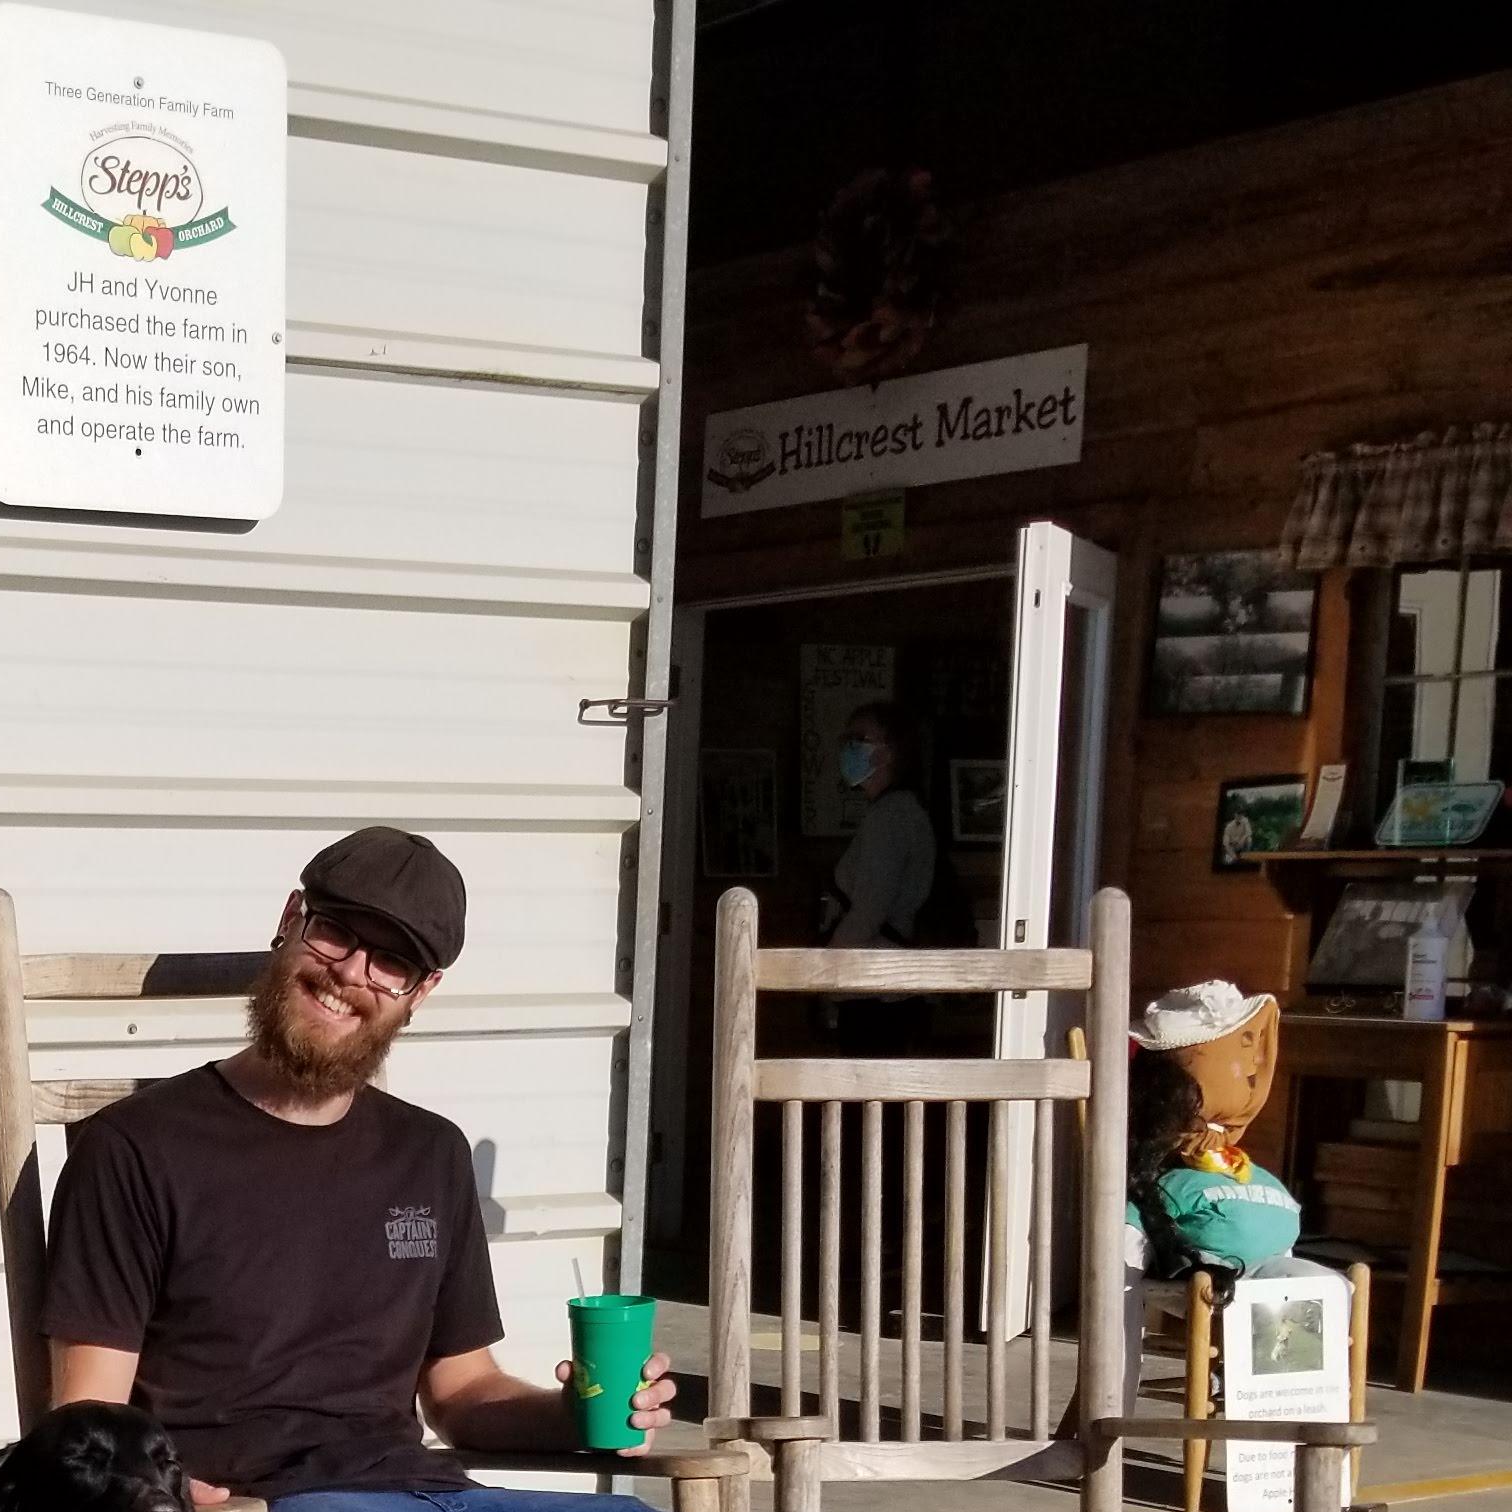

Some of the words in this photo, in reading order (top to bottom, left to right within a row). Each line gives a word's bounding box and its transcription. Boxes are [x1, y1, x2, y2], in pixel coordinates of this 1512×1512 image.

[45, 81, 82, 99] Three
[86, 87, 155, 109] Generation
[159, 97, 199, 117] Family
[203, 103, 234, 119] Farm
[89, 122, 129, 142] Harvesting
[131, 120, 156, 135] Family
[159, 125, 194, 154] Memories
[51, 198, 104, 233] HILLCREST
[178, 216, 224, 242] ORCHARD
[67, 272, 93, 294] JH
[101, 277, 137, 298] and
[145, 279, 218, 306] Yvonne
[36, 308, 139, 334] purchased
[146, 316, 176, 337] the
[183, 318, 225, 342] farm
[231, 323, 247, 343] in
[43, 342, 96, 366] 1964.
[105, 347, 147, 370] Now
[154, 352, 197, 375] their
[202, 359, 242, 381] son,
[22, 376, 74, 403] Mike,
[82, 383, 118, 404] and
[126, 385, 153, 406] his
[159, 387, 216, 416] family
[222, 397, 260, 415] own
[37, 416, 74, 436] and
[81, 421, 155, 442] operate
[162, 423, 191, 444] the
[198, 426, 245, 449] farm.
[778, 413, 924, 475] Hillcrest
[935, 385, 1077, 448] Market
[843, 646, 887, 667] APPLE
[814, 668, 886, 689] FESTIVAL
[1236, 1389, 1257, 1401] Dogs
[1259, 1389, 1274, 1400] are
[1275, 1387, 1314, 1398] welcome
[1248, 1405, 1282, 1418] orchard
[1283, 1407, 1295, 1416] on
[1239, 1452, 1256, 1463] Due
[1257, 1451, 1267, 1461] to
[1255, 1471, 1269, 1481] are
[1271, 1469, 1285, 1479] not
